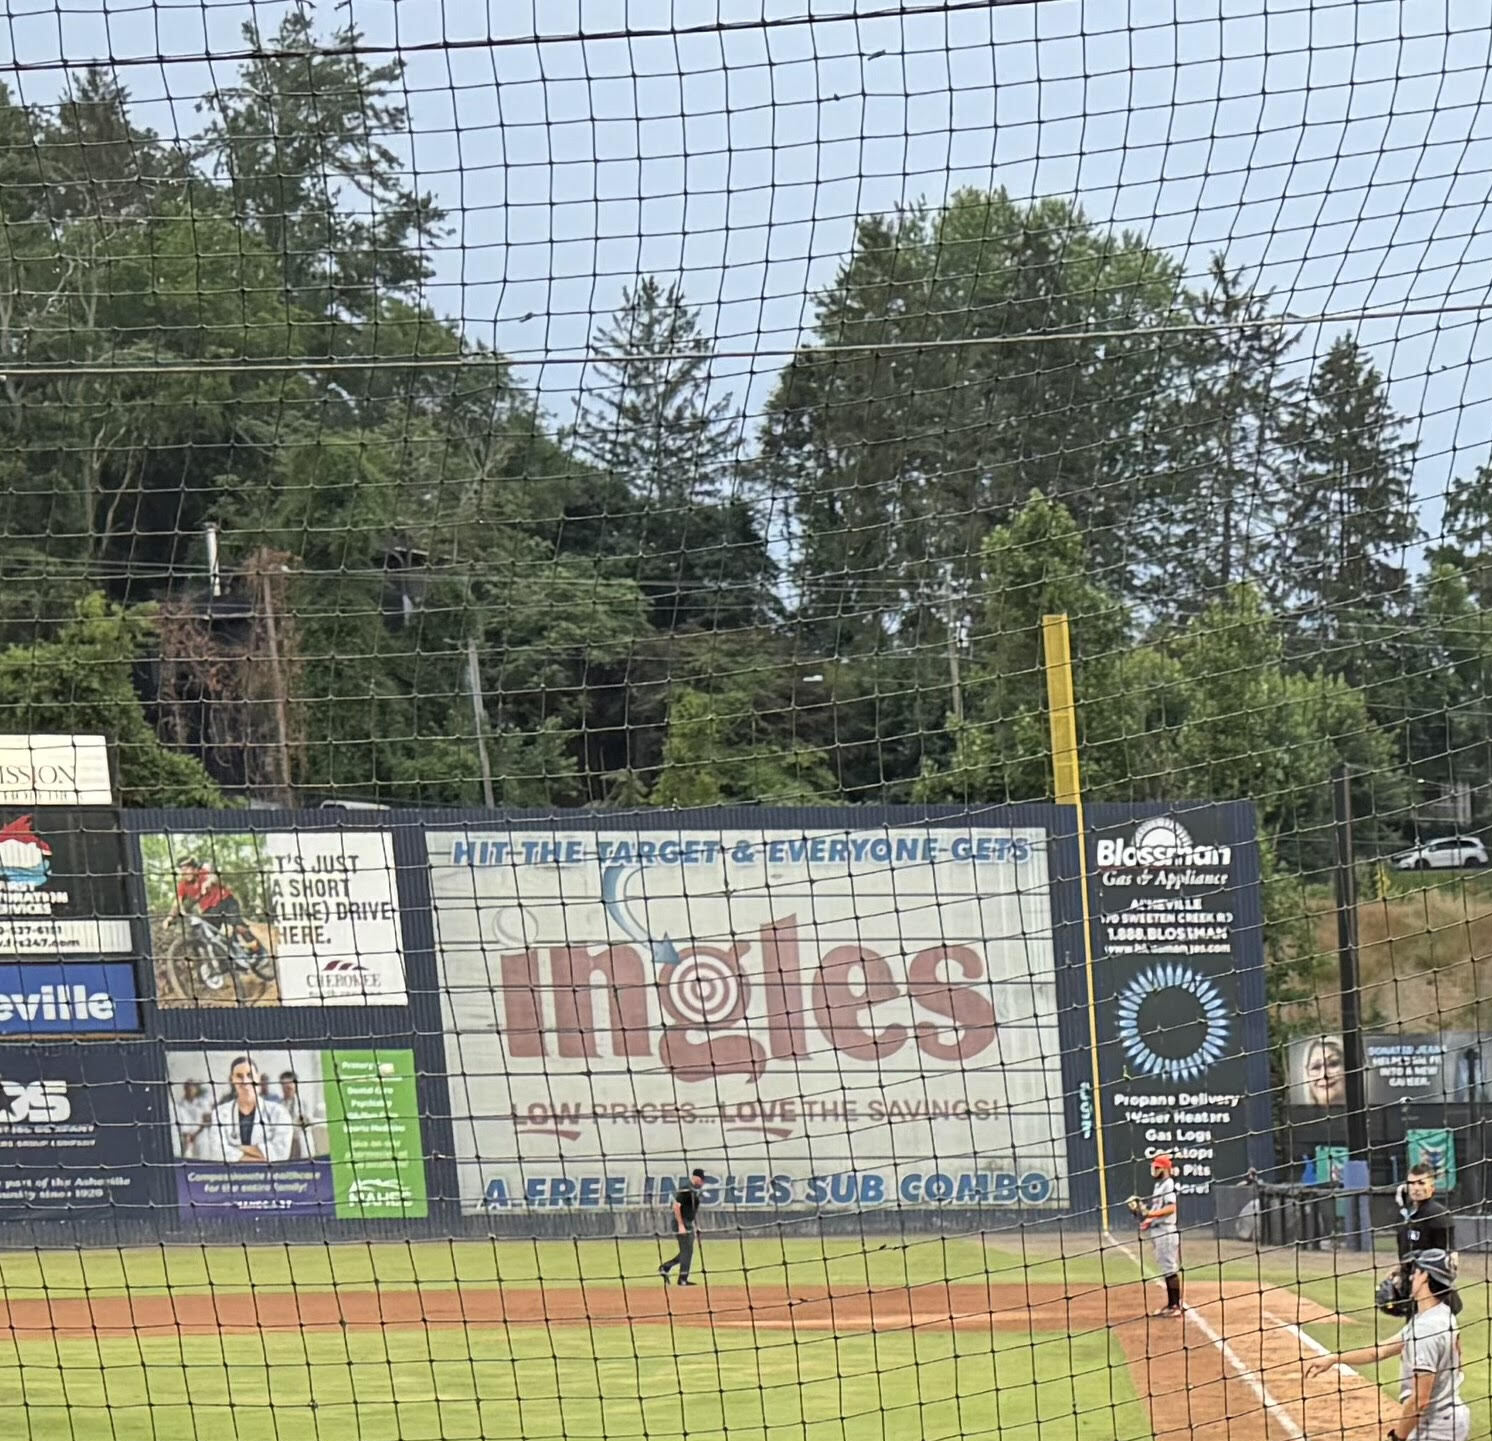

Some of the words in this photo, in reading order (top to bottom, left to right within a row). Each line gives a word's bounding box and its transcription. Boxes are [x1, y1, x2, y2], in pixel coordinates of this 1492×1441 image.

[453, 839, 518, 865] HIT
[522, 839, 583, 865] THE
[597, 838, 722, 864] TARGET
[732, 838, 758, 863] &
[769, 836, 940, 863] EVERYONE
[951, 836, 1033, 862] GETS
[1097, 838, 1231, 867] Blossman
[312, 854, 359, 874] JUST
[272, 879, 284, 897] A
[290, 878, 350, 897] SHORT
[1102, 870, 1132, 887] Gas
[1154, 869, 1228, 890] Appliance
[273, 900, 330, 923] (LINE)
[336, 901, 392, 920] DRIVE
[278, 925, 332, 944] HERE.
[501, 910, 997, 1084] ingles
[1114, 1093, 1175, 1107] Propane
[1178, 1093, 1241, 1107] Delivery
[513, 1101, 581, 1126] LOW
[723, 1100, 797, 1125] LOVE
[808, 1100, 858, 1124] THE
[867, 1099, 1001, 1124] SAVINGS!
[1173, 1111, 1231, 1124] Heaters
[1145, 1130, 1172, 1141] Gas
[1176, 1130, 1211, 1142] Logs
[484, 1176, 519, 1210] A
[526, 1175, 626, 1209] FREE
[645, 1173, 797, 1207] INGLES
[805, 1172, 887, 1206] SUB
[900, 1171, 1054, 1204] COMBO
